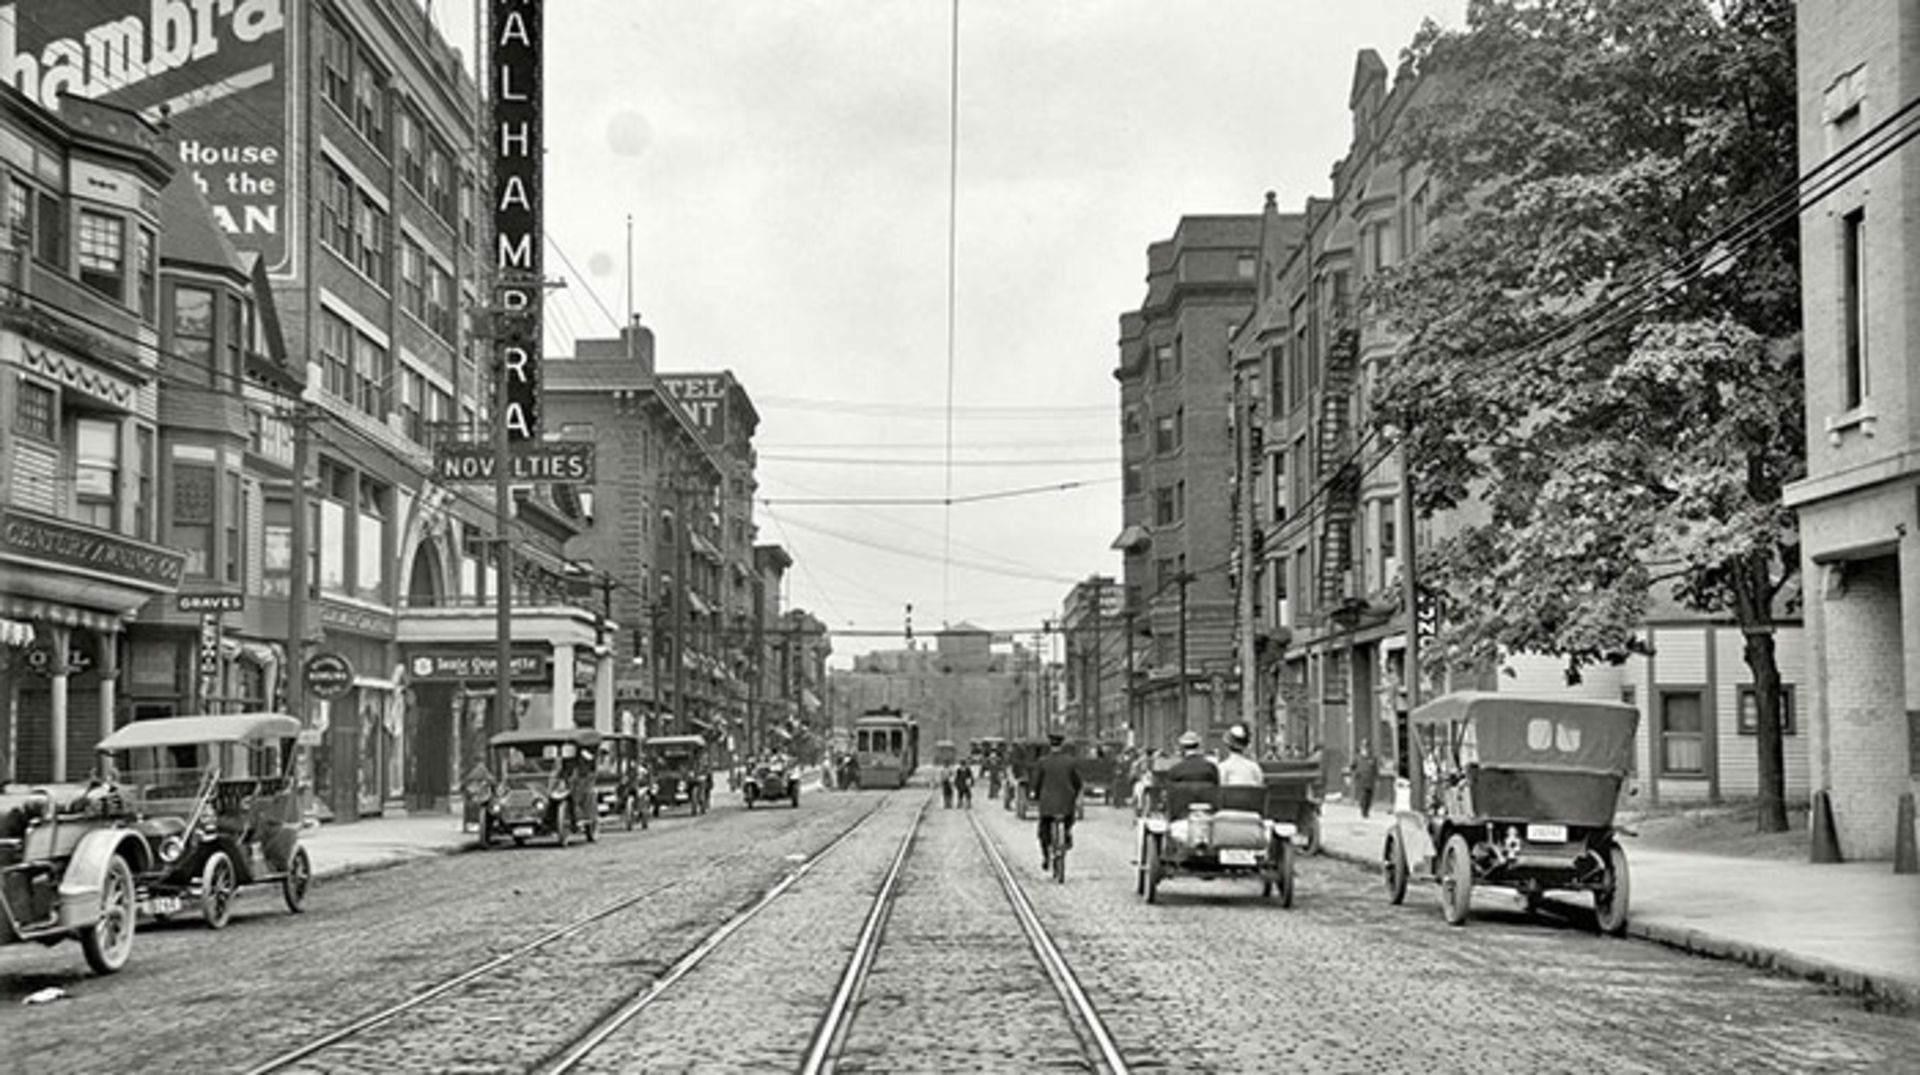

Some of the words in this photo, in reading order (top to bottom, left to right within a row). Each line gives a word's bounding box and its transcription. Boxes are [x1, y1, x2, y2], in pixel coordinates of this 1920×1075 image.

[180, 140, 279, 165] House
[225, 172, 275, 195] the
[445, 456, 583, 477] NOVLTIES
